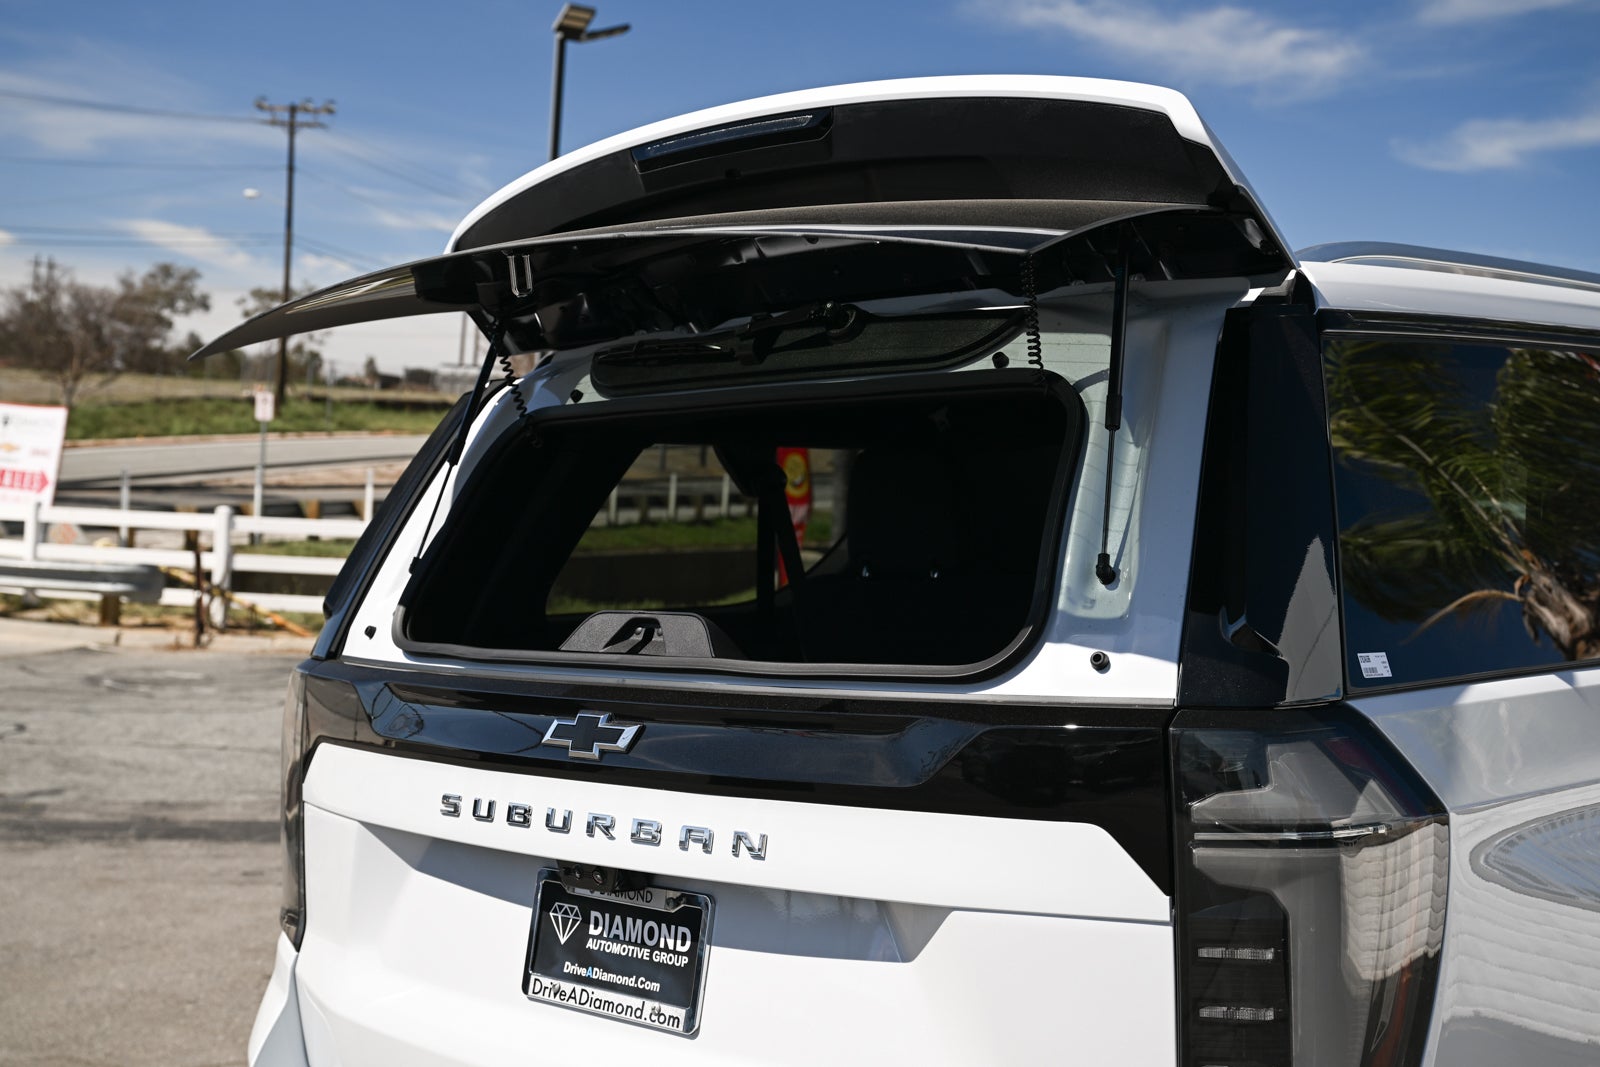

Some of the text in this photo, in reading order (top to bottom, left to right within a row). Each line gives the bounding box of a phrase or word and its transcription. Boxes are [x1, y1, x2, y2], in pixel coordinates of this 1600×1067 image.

[440, 793, 768, 860] SUBURBAN
[600, 887, 653, 903] AMOND
[588, 910, 692, 952] DIAMOND
[585, 938, 689, 967] AUTOMOTIVE GROUP
[563, 961, 661, 992] DriveADiamond.Com
[532, 978, 680, 1029] DriveADiamond.com
